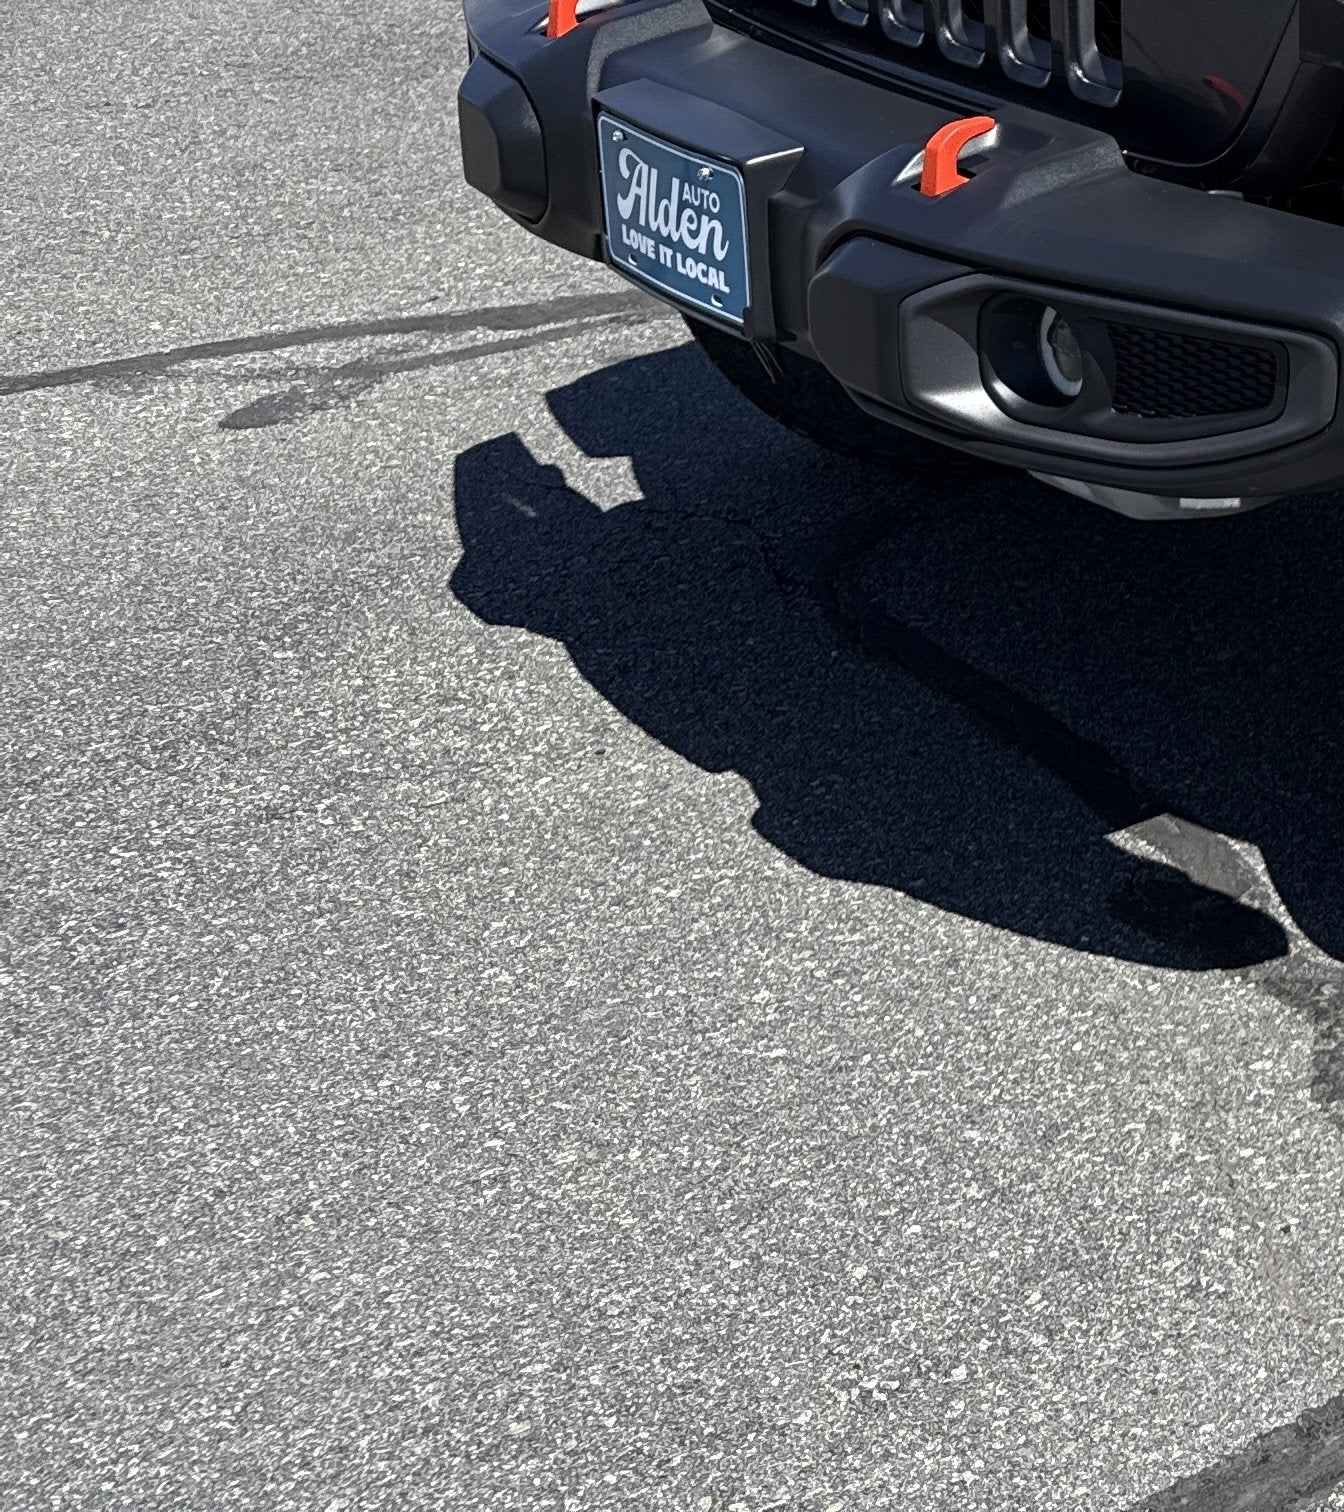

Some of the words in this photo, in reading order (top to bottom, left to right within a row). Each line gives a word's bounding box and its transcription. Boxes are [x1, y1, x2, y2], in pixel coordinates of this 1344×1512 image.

[616, 147, 730, 262] Alden
[682, 181, 721, 214] AUTO
[621, 223, 656, 260] LOVE
[658, 243, 673, 269] IT
[676, 251, 731, 294] LOCAL
